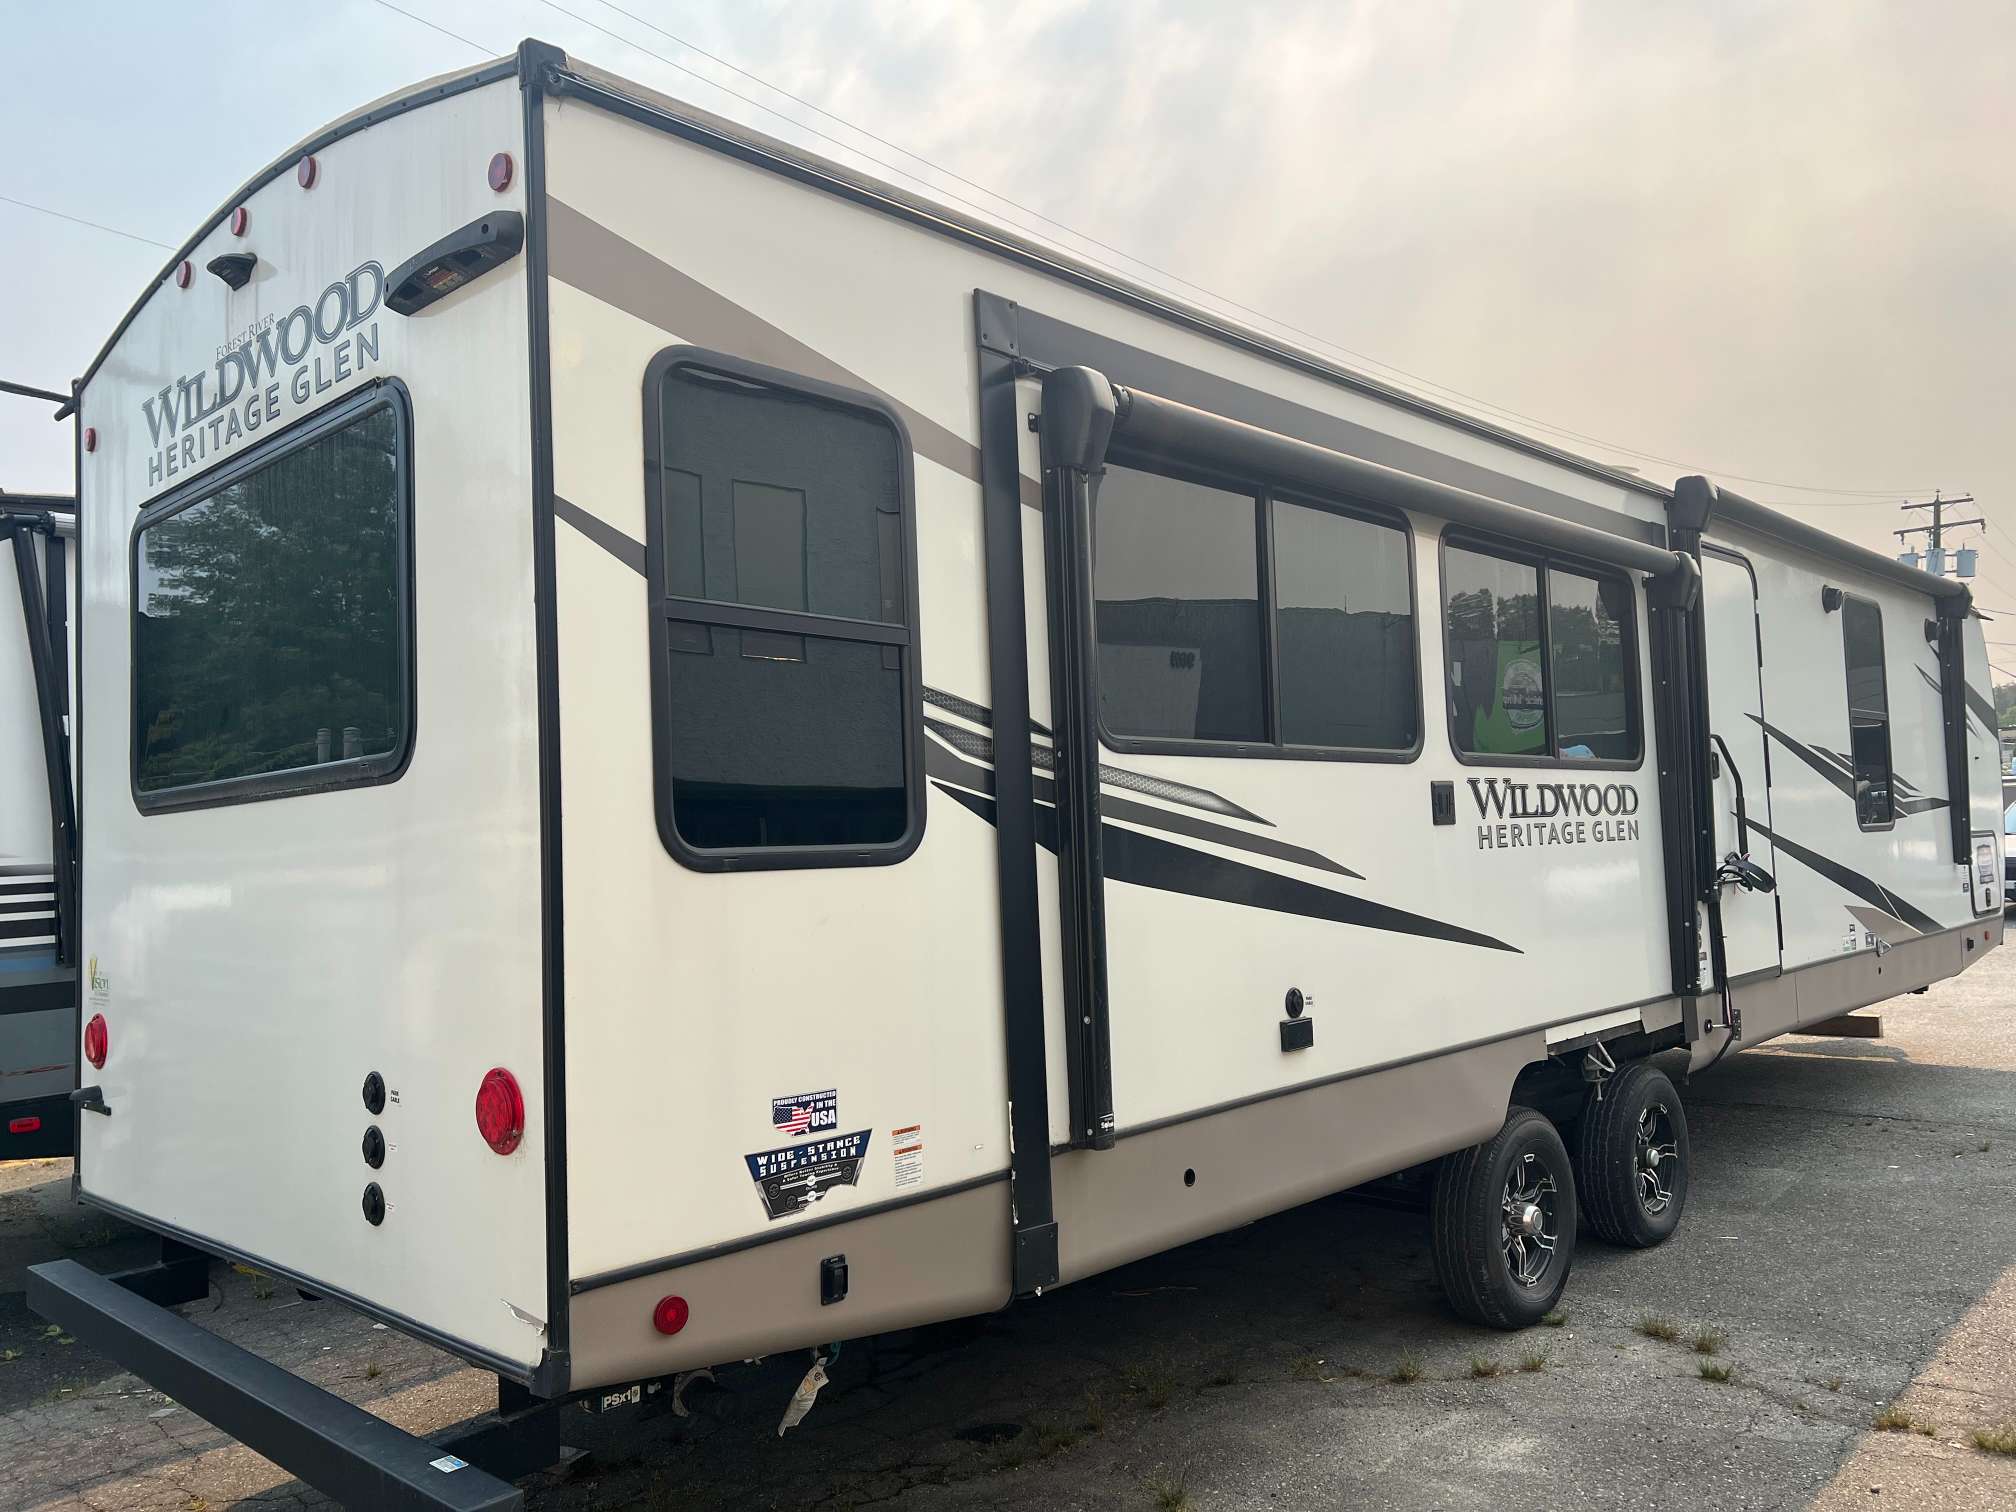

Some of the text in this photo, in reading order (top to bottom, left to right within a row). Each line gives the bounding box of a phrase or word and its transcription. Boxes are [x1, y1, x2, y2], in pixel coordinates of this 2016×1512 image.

[141, 260, 385, 448] WILDWOOD
[216, 312, 274, 360] FOREST RIVER
[149, 323, 379, 487] HERITAGE GLEN
[1467, 777, 1639, 819] WILDWOOD
[1477, 820, 1640, 849] HERITAGE GLEN
[811, 1109, 836, 1127] USA
[816, 1099, 836, 1109] IN THE
[760, 1146, 857, 1178] SUSPENSION
